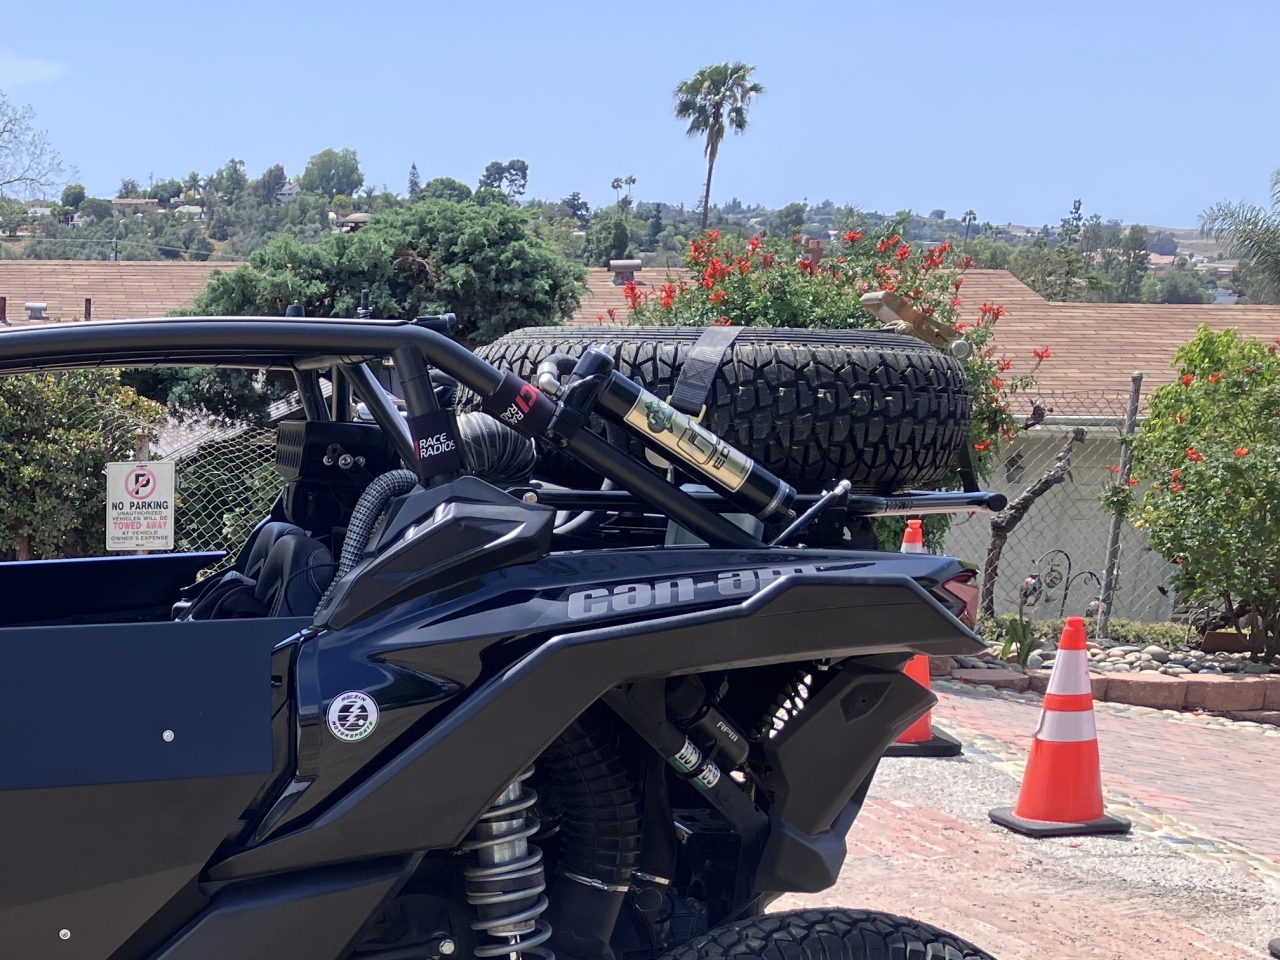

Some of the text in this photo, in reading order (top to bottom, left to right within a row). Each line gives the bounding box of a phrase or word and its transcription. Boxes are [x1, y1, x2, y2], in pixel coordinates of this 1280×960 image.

[419, 432, 447, 450] RACE
[420, 440, 456, 459] RADIOS
[111, 501, 169, 510] NO PARKING
[112, 520, 168, 530] TOWED AWAY
[331, 720, 373, 738] MOTORSPORTS
